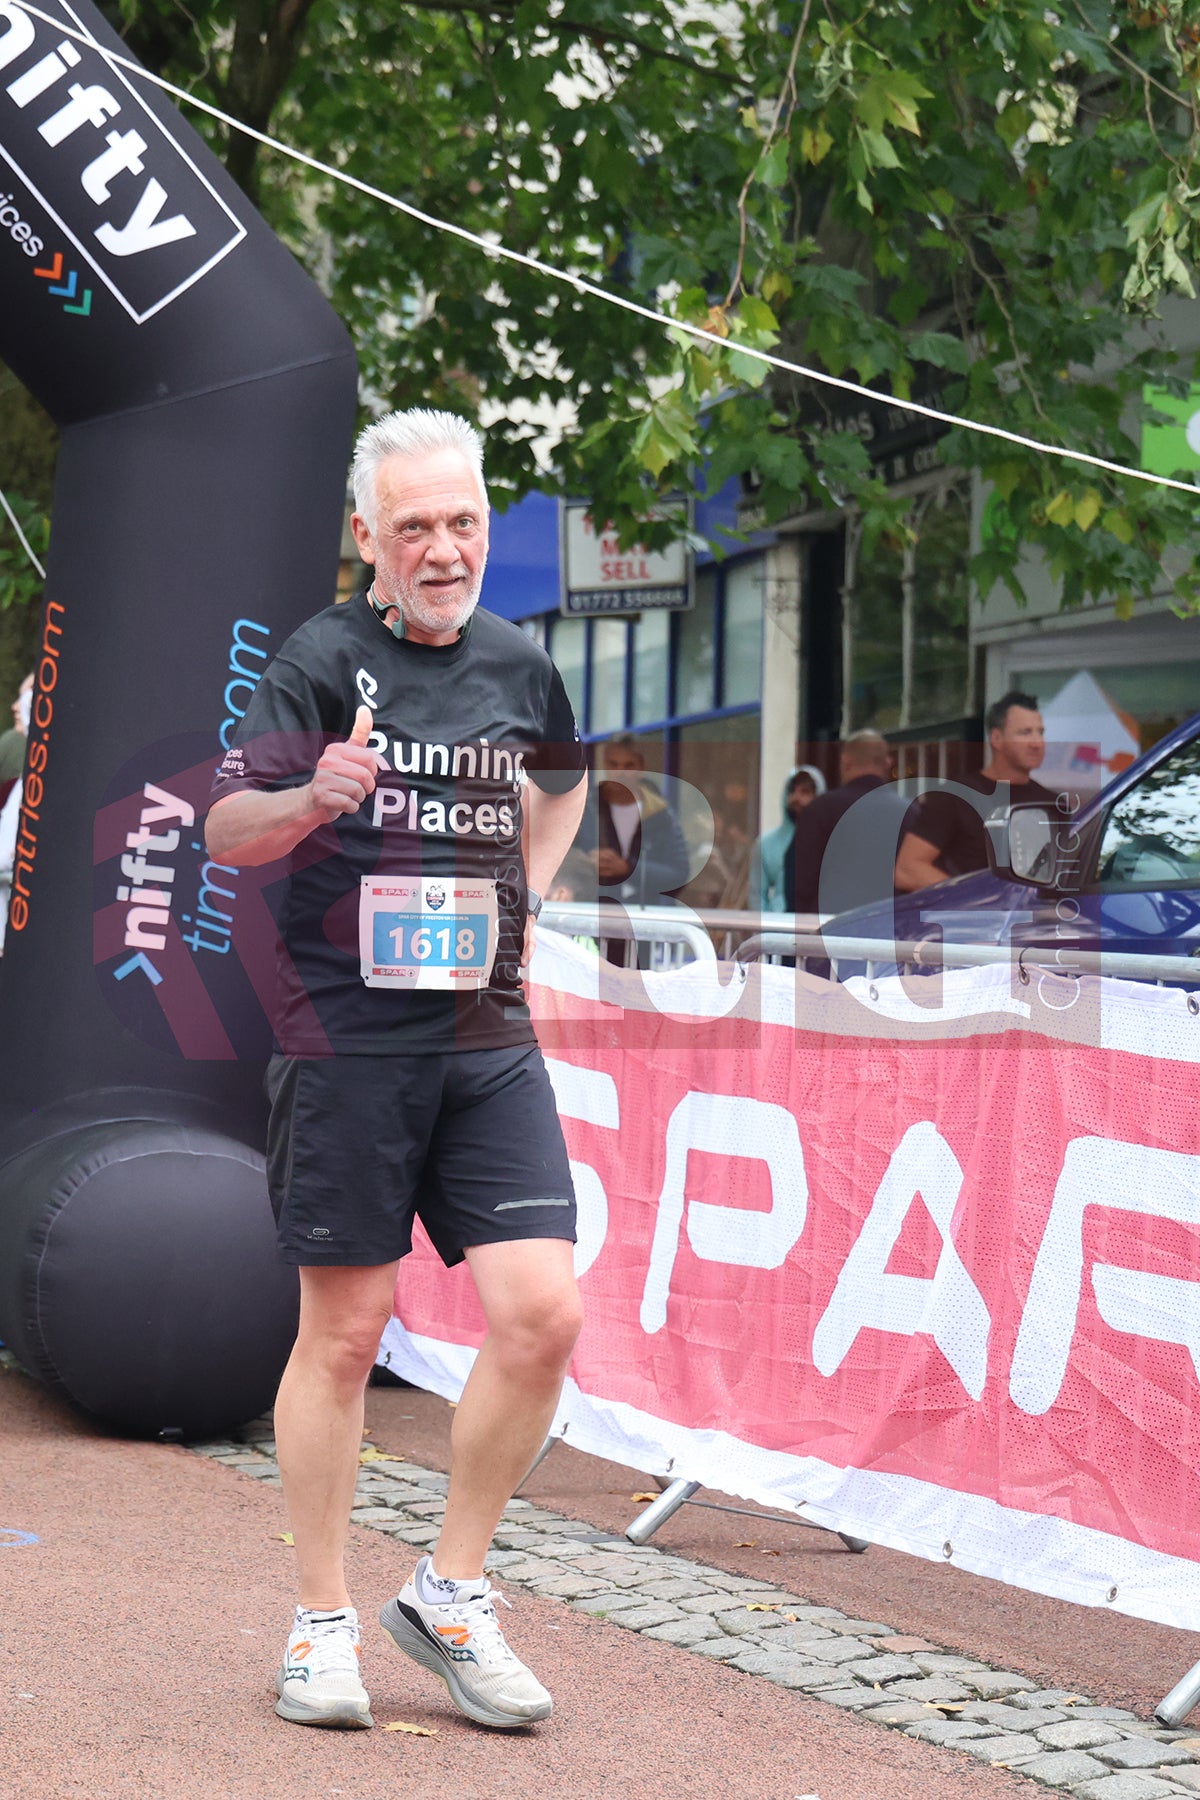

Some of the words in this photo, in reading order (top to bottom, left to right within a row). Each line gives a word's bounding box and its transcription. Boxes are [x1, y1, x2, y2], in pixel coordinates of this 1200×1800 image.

[0, 193, 44, 257] ices
[600, 560, 651, 582] SELL
[10, 600, 66, 932] entries.com
[371, 787, 514, 837] Places
[116, 782, 195, 951] nifty
[381, 888, 409, 897] SPAR
[389, 926, 475, 961] 1618
[379, 968, 406, 976] SPAR
